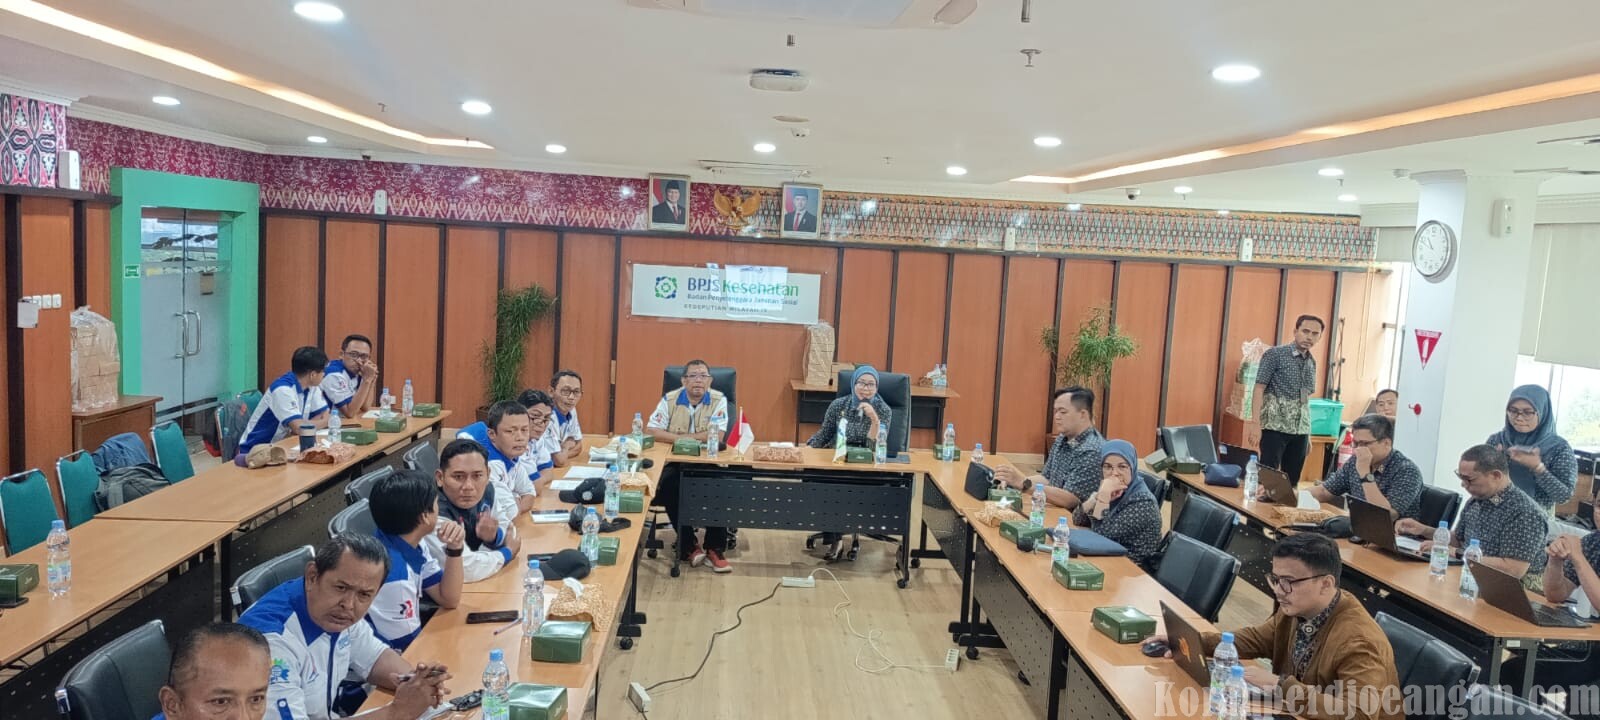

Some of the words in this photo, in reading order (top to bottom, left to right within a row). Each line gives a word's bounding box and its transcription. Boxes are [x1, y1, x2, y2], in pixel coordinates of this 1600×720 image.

[687, 277, 720, 292] BPJS
[722, 279, 799, 297] Kesehatan
[687, 293, 707, 301] Badan
